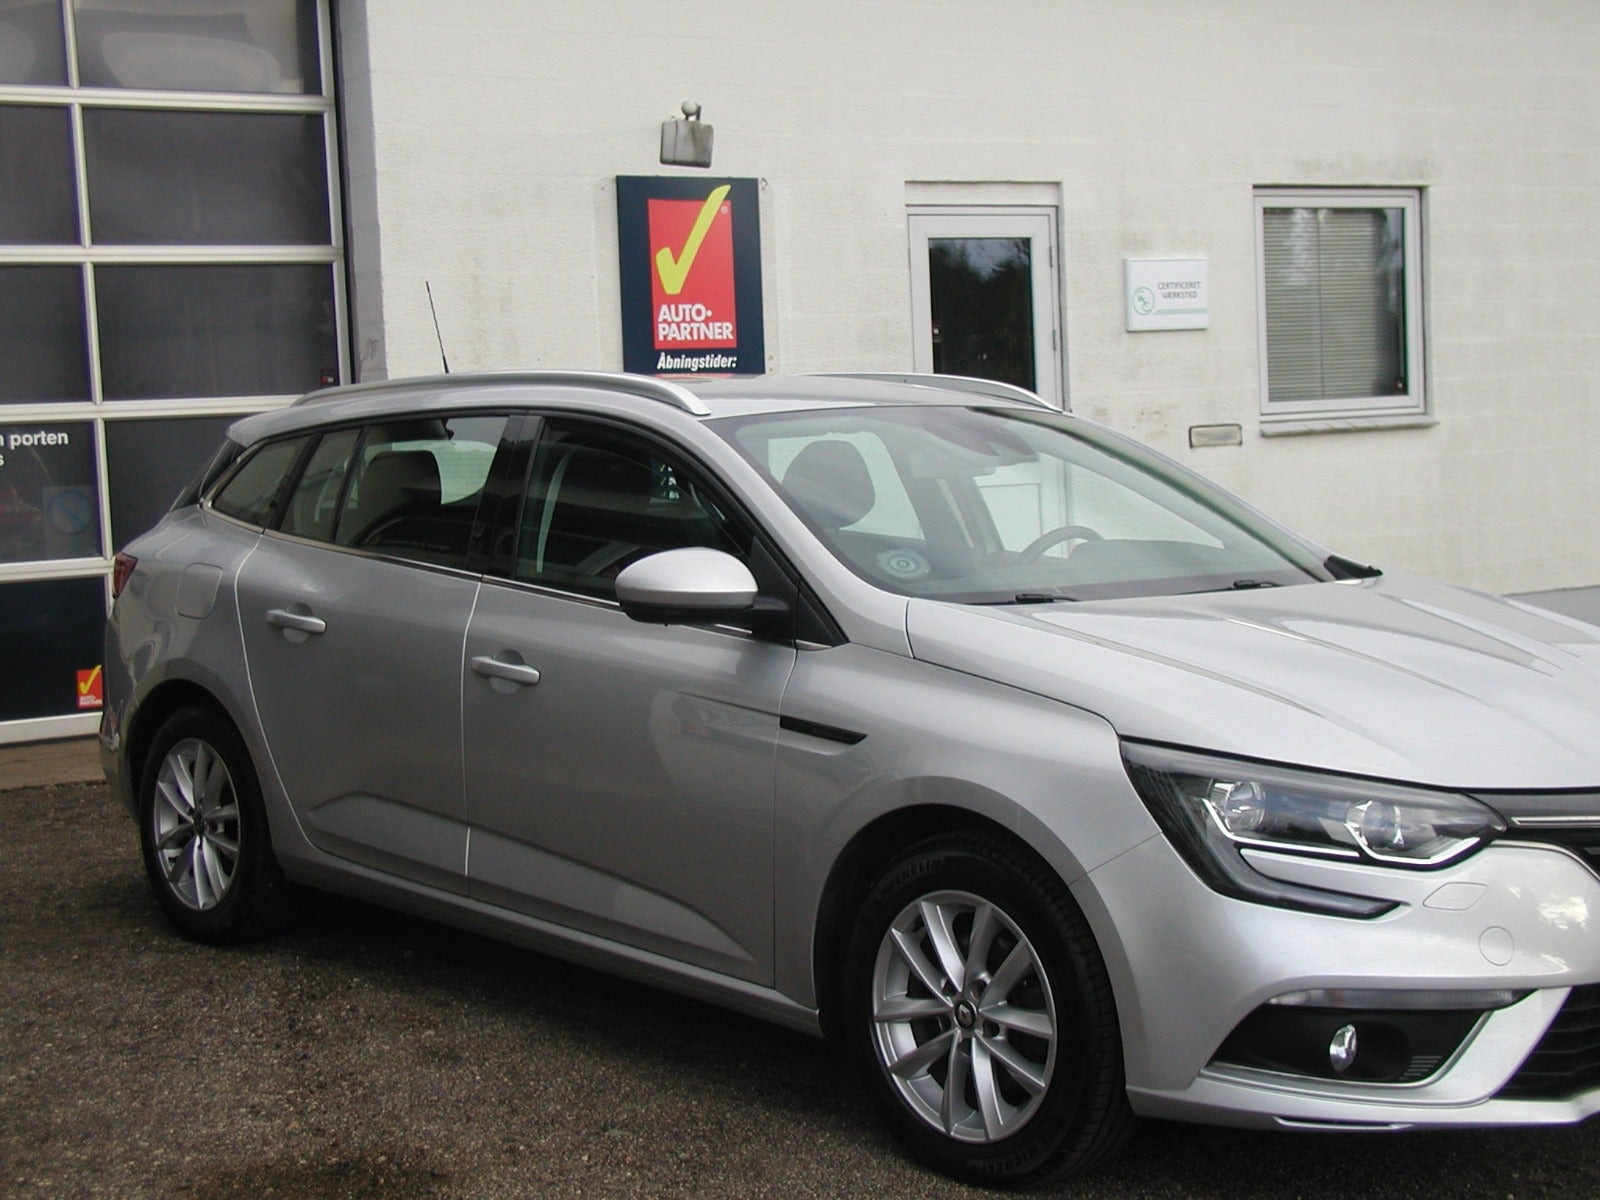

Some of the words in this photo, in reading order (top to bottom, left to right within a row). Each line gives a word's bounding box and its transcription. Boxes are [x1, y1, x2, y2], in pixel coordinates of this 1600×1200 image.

[657, 321, 734, 341] PARTNER
[656, 352, 738, 372] Åbningstider:
[9, 430, 69, 450] porten
